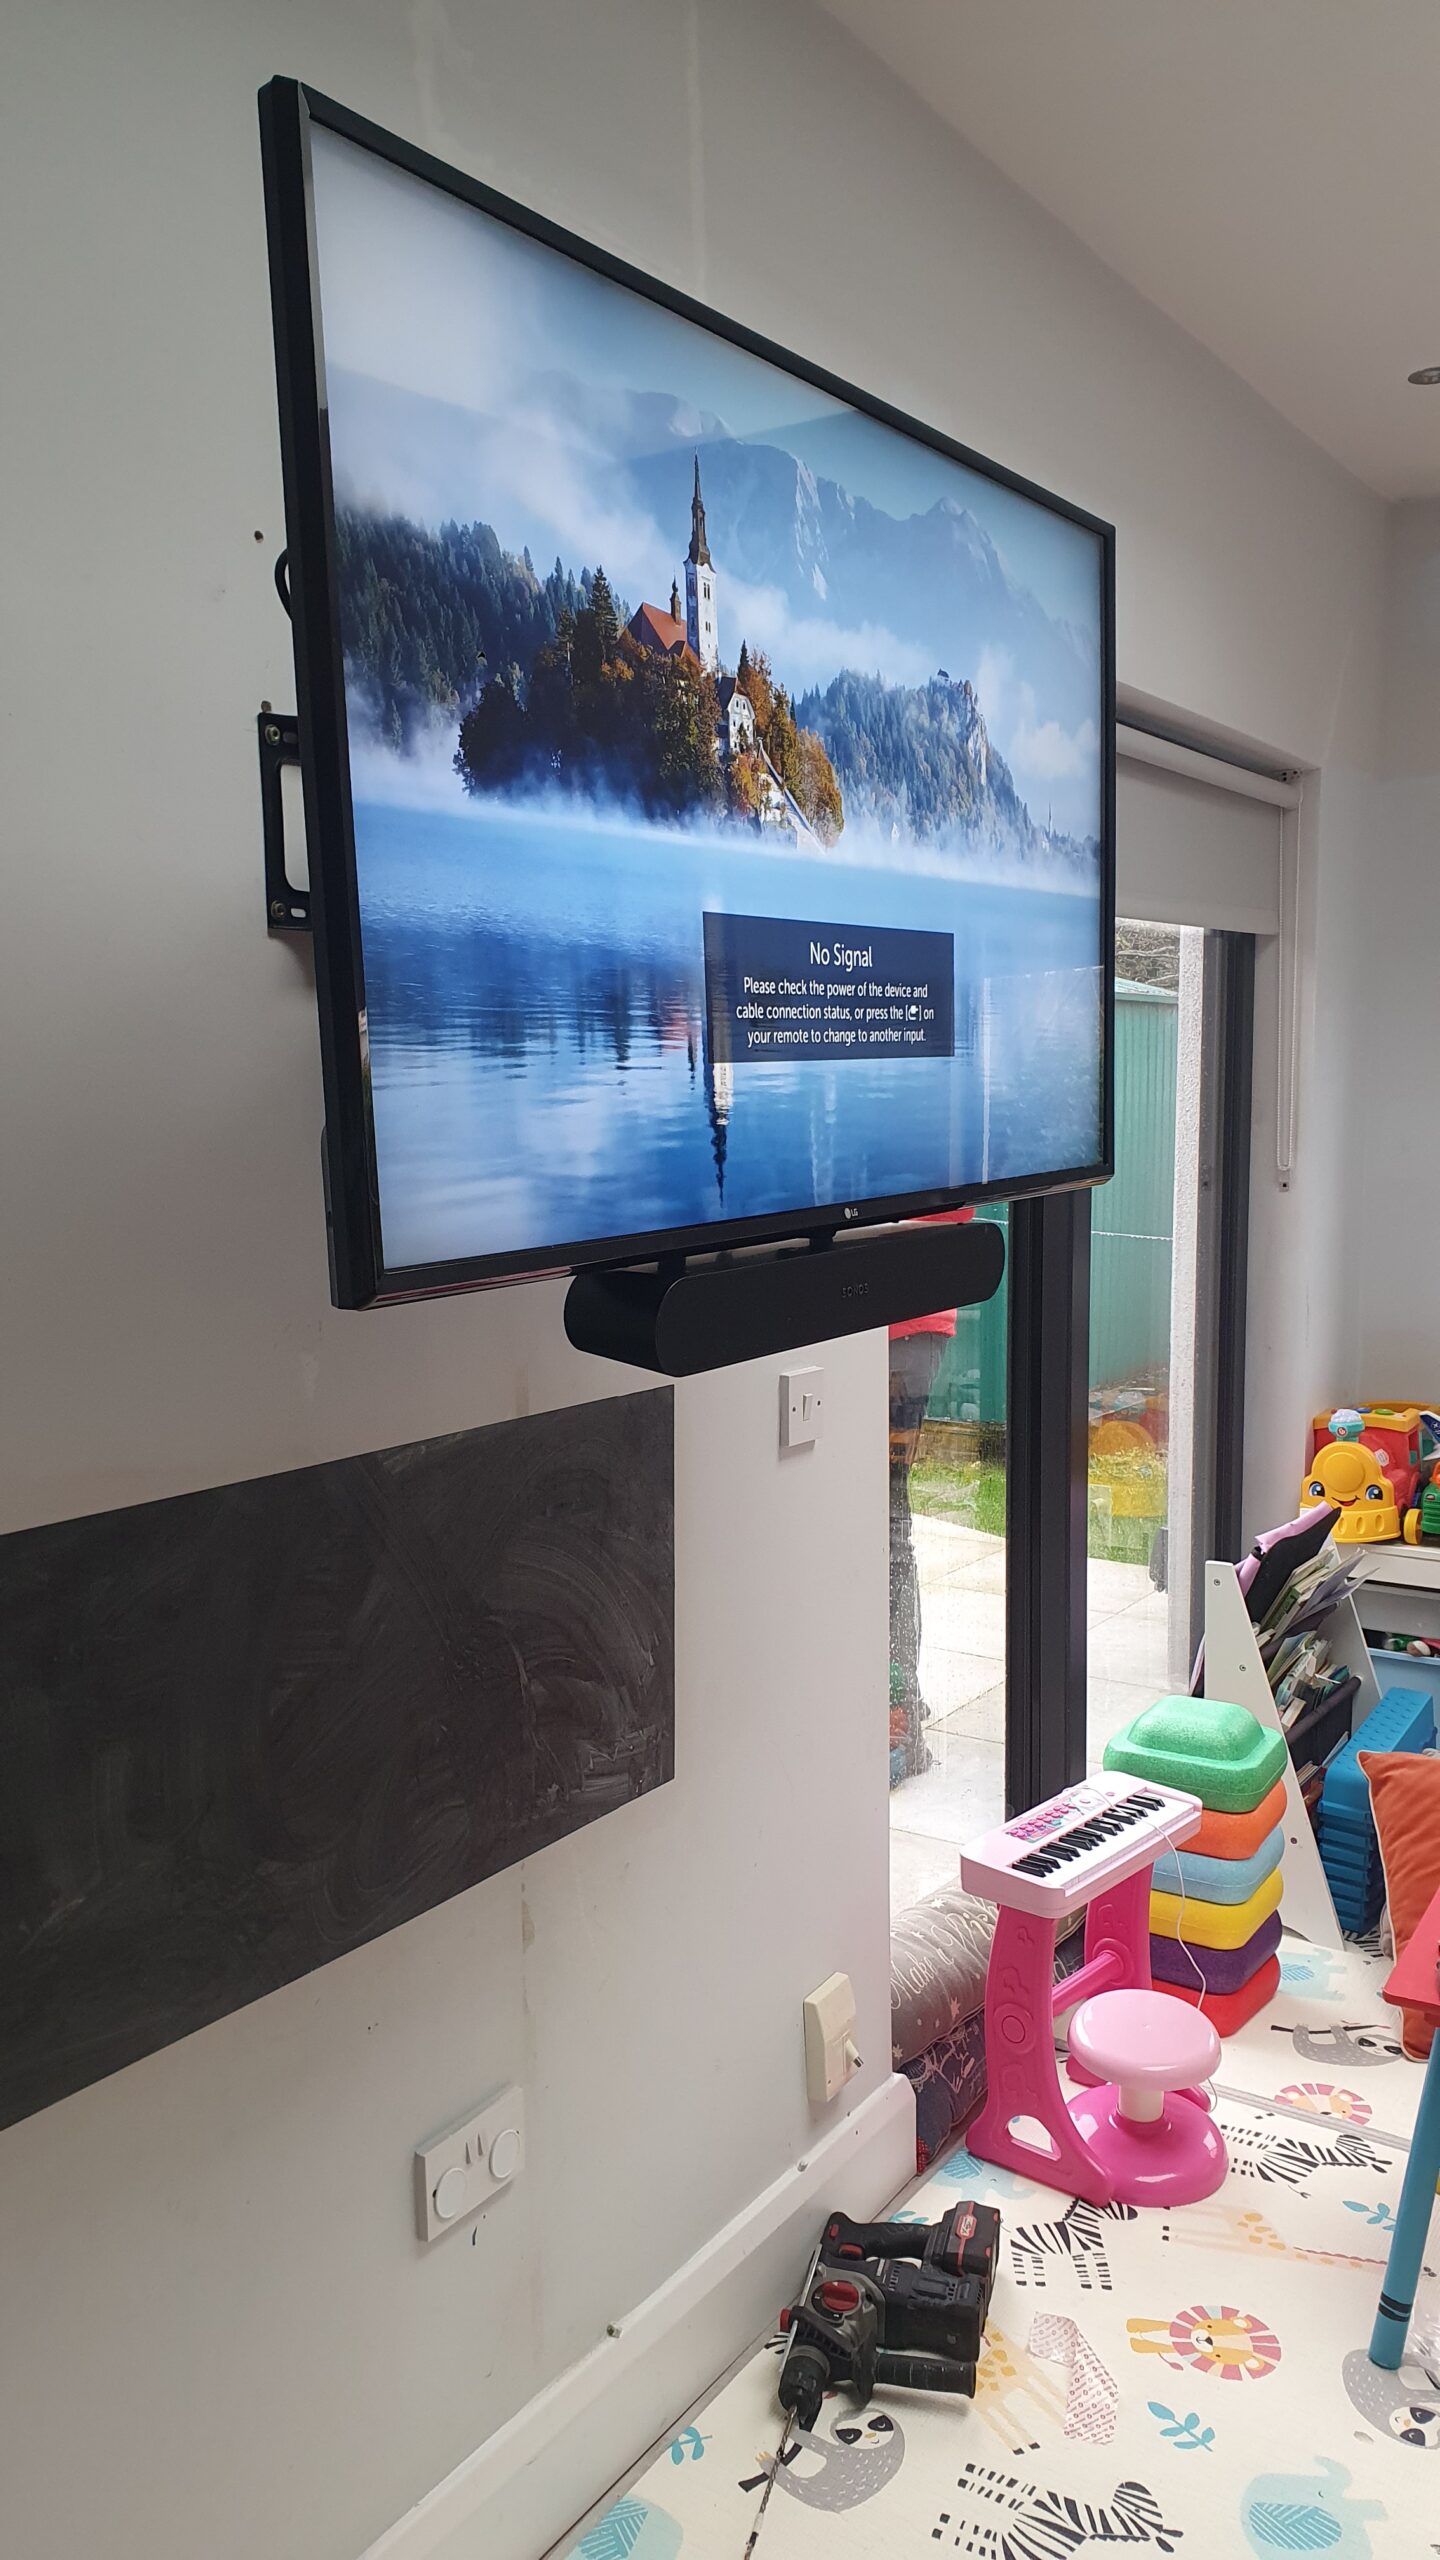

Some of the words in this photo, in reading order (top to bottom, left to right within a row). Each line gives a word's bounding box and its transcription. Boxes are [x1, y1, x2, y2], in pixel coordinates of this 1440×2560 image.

[809, 941, 830, 966] No
[833, 943, 873, 972] Signal
[743, 976, 776, 994] Please
[778, 978, 808, 995] check
[809, 979, 825, 996] the
[826, 983, 856, 999] power
[857, 981, 868, 997] of
[868, 982, 883, 997] the
[884, 983, 912, 998] device
[912, 984, 928, 998] and
[736, 1002, 764, 1019] cable
[766, 1003, 822, 1020] connection
[823, 1005, 852, 1021] status,
[854, 1007, 865, 1020] or
[866, 1007, 889, 1023] press
[889, 1005, 904, 1020] the
[923, 1008, 935, 1020] on
[747, 1030, 772, 1048] your
[773, 1028, 809, 1044] remote
[811, 1028, 822, 1043] to
[823, 1027, 856, 1047] change
[857, 1028, 868, 1043] to
[869, 1027, 902, 1043] another
[903, 1027, 927, 1046] input.
[842, 1282, 870, 1298] SONOS
